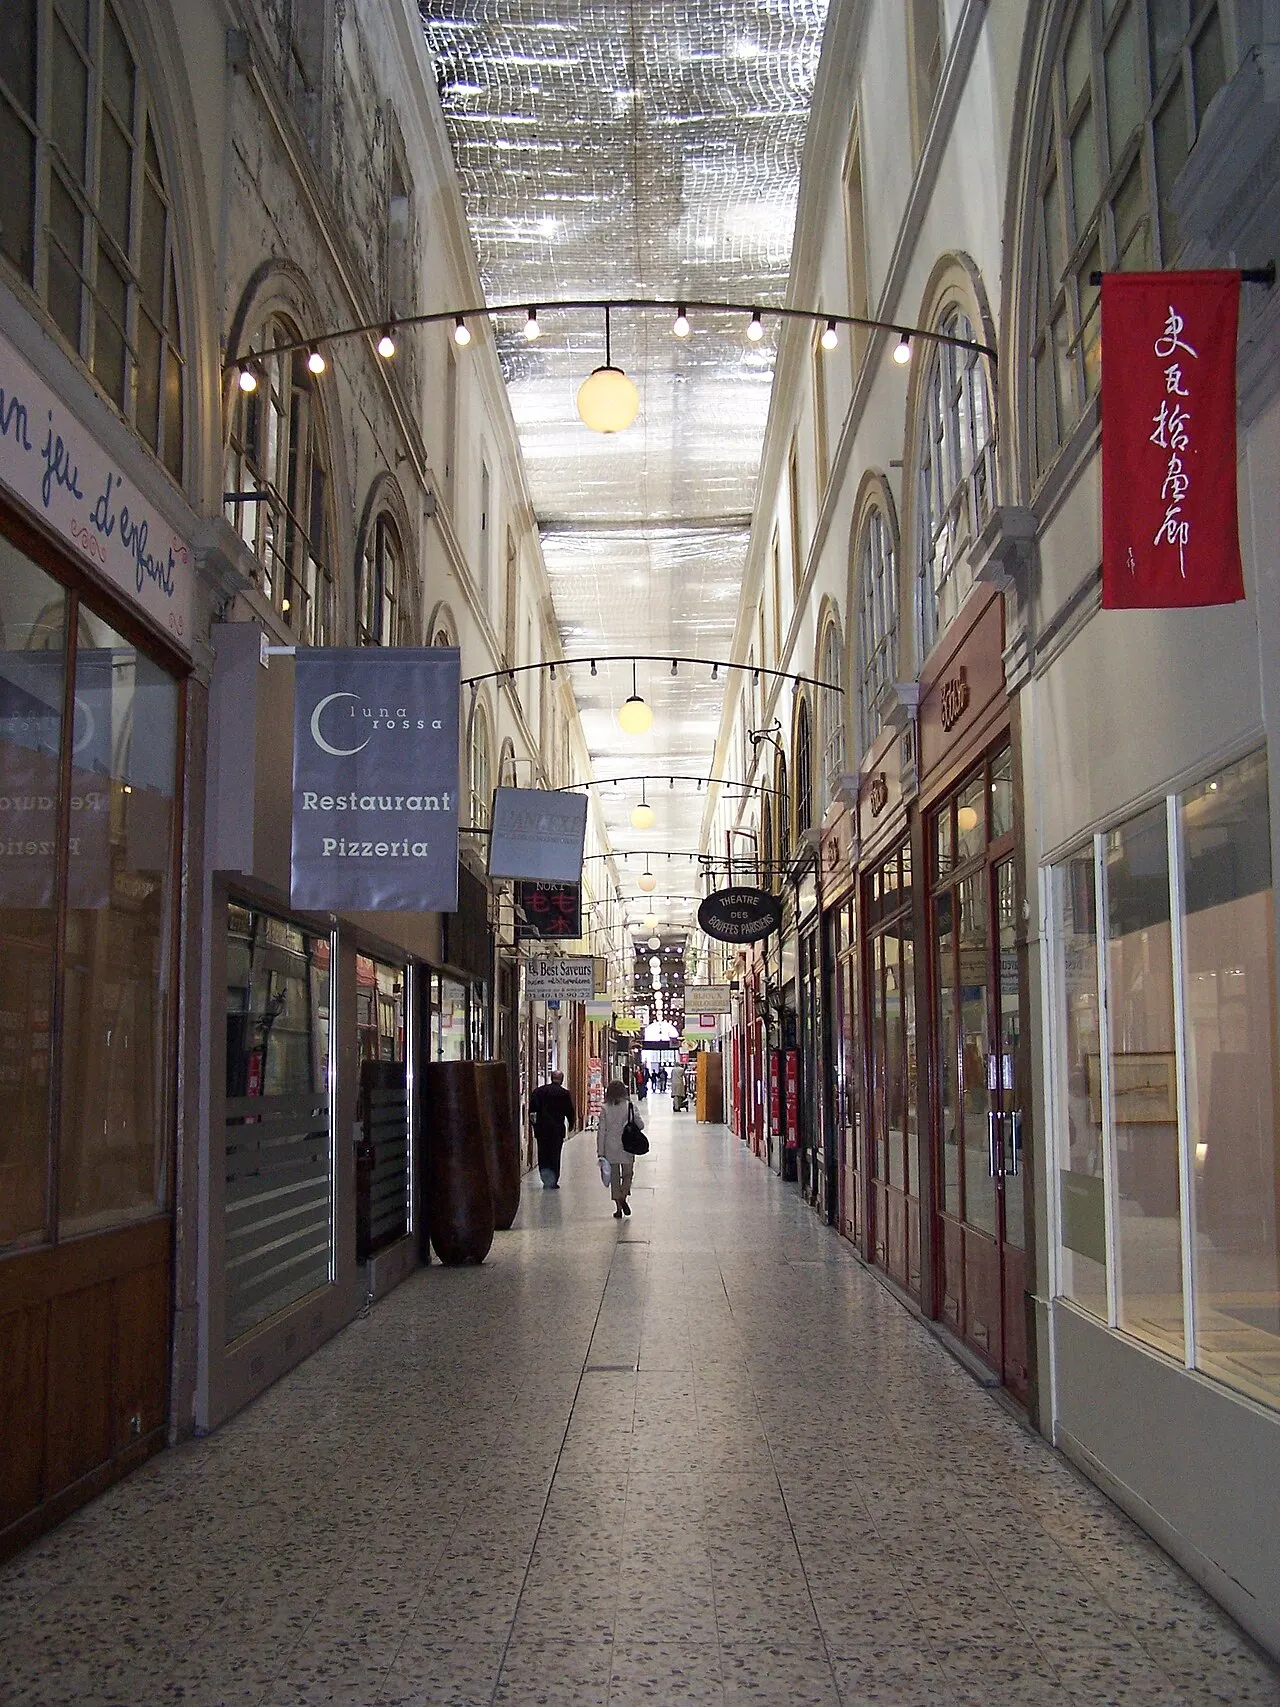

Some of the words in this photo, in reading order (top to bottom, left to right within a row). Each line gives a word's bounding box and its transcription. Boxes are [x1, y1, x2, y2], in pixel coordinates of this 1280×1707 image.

[41, 409, 84, 508] jeu
[89, 472, 176, 598] d'enfant
[372, 718, 442, 729] rossa
[301, 791, 451, 812] Restaurant
[321, 837, 429, 858] Pizzeria
[718, 894, 760, 907] THEATRE
[708, 914, 740, 935] BOUFFES
[740, 913, 774, 935] PARISIENS
[730, 911, 749, 919] DES
[540, 961, 559, 976] Best
[560, 961, 592, 976] Saveurs
